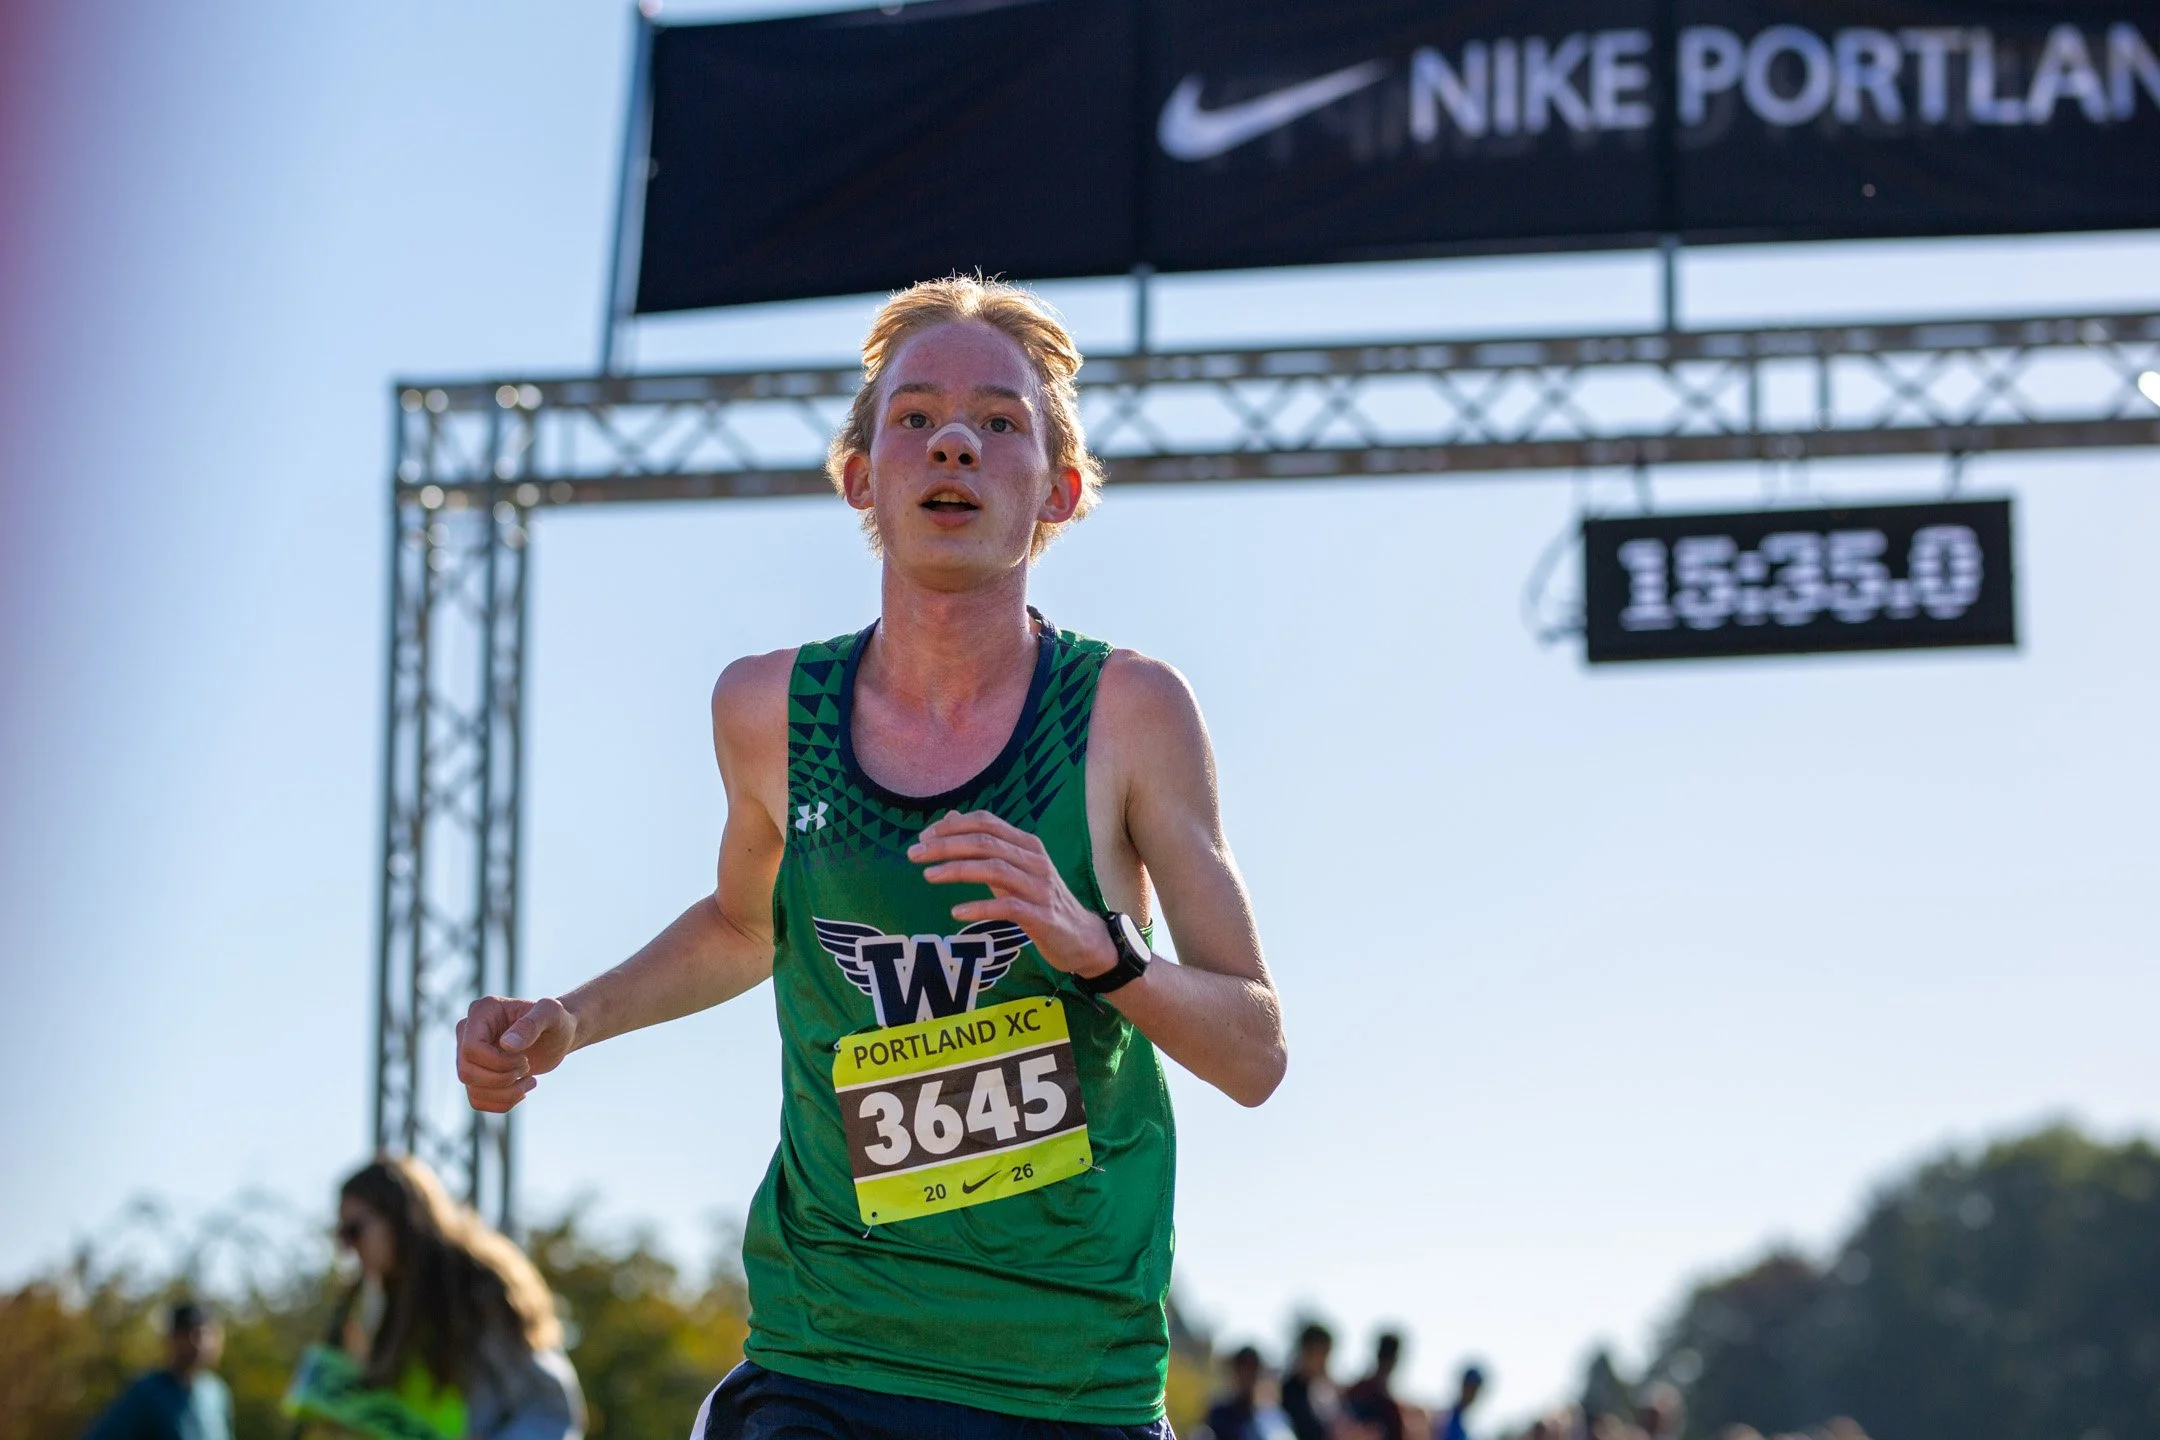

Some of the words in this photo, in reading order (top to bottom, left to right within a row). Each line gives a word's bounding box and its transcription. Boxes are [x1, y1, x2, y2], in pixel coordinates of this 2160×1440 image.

[1409, 29, 1653, 143] NIKE
[1617, 525, 1983, 631] 15:35.0
[858, 937, 991, 1028] W
[854, 1019, 996, 1069] PORTLAND
[1005, 1008, 1041, 1037] XC
[859, 1054, 1067, 1166] 3645
[923, 1183, 947, 1202] 20
[1011, 1163, 1034, 1182] 26
